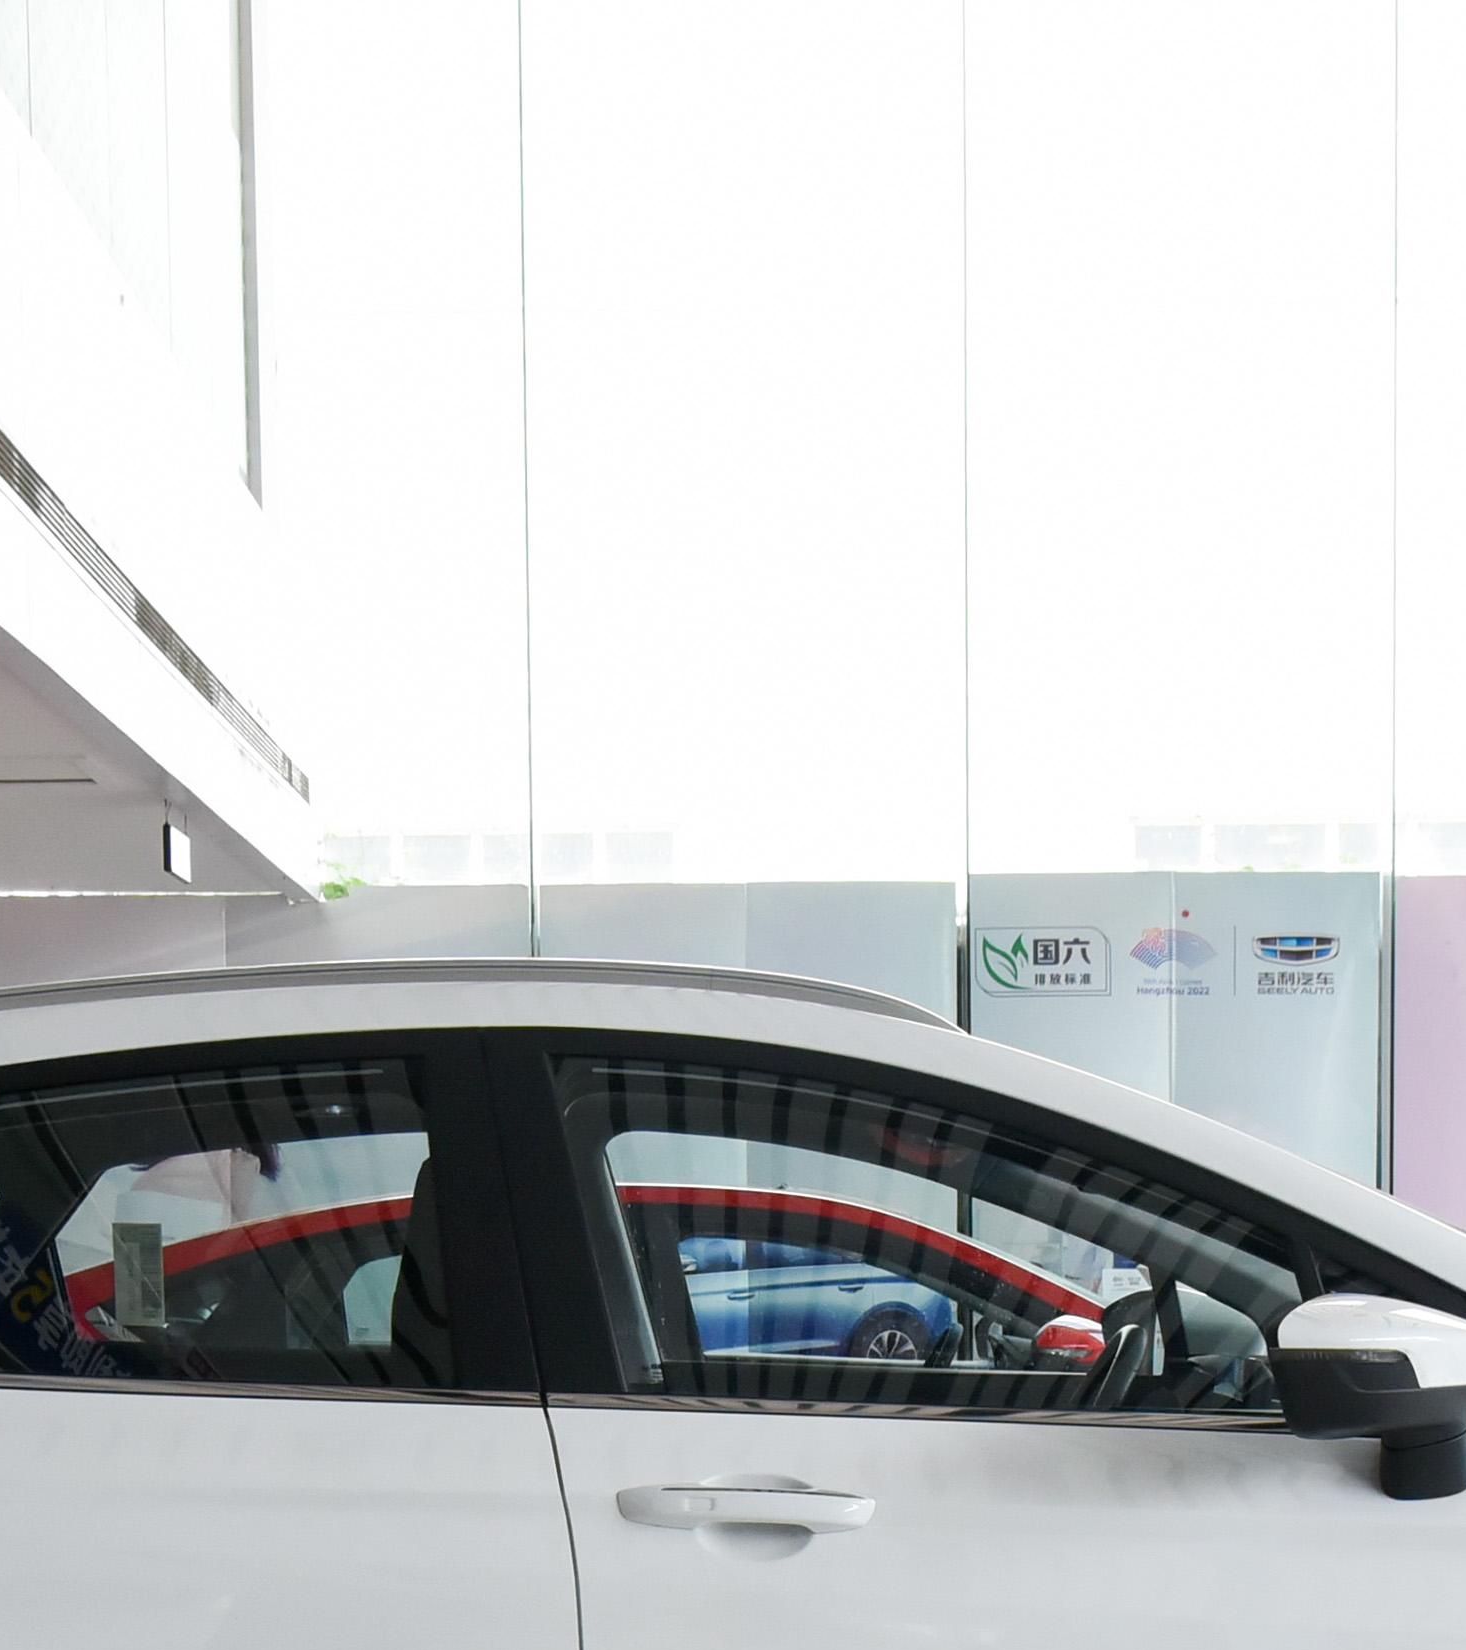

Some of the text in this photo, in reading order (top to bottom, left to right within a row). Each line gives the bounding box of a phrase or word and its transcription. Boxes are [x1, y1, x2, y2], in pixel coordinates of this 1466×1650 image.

[1032, 937, 1092, 966] 国六
[1034, 972, 1092, 986] 排放标准
[1257, 971, 1334, 986] 吉利汽车
[1186, 986, 1210, 996] 2022
[1299, 986, 1335, 995] AUTO
